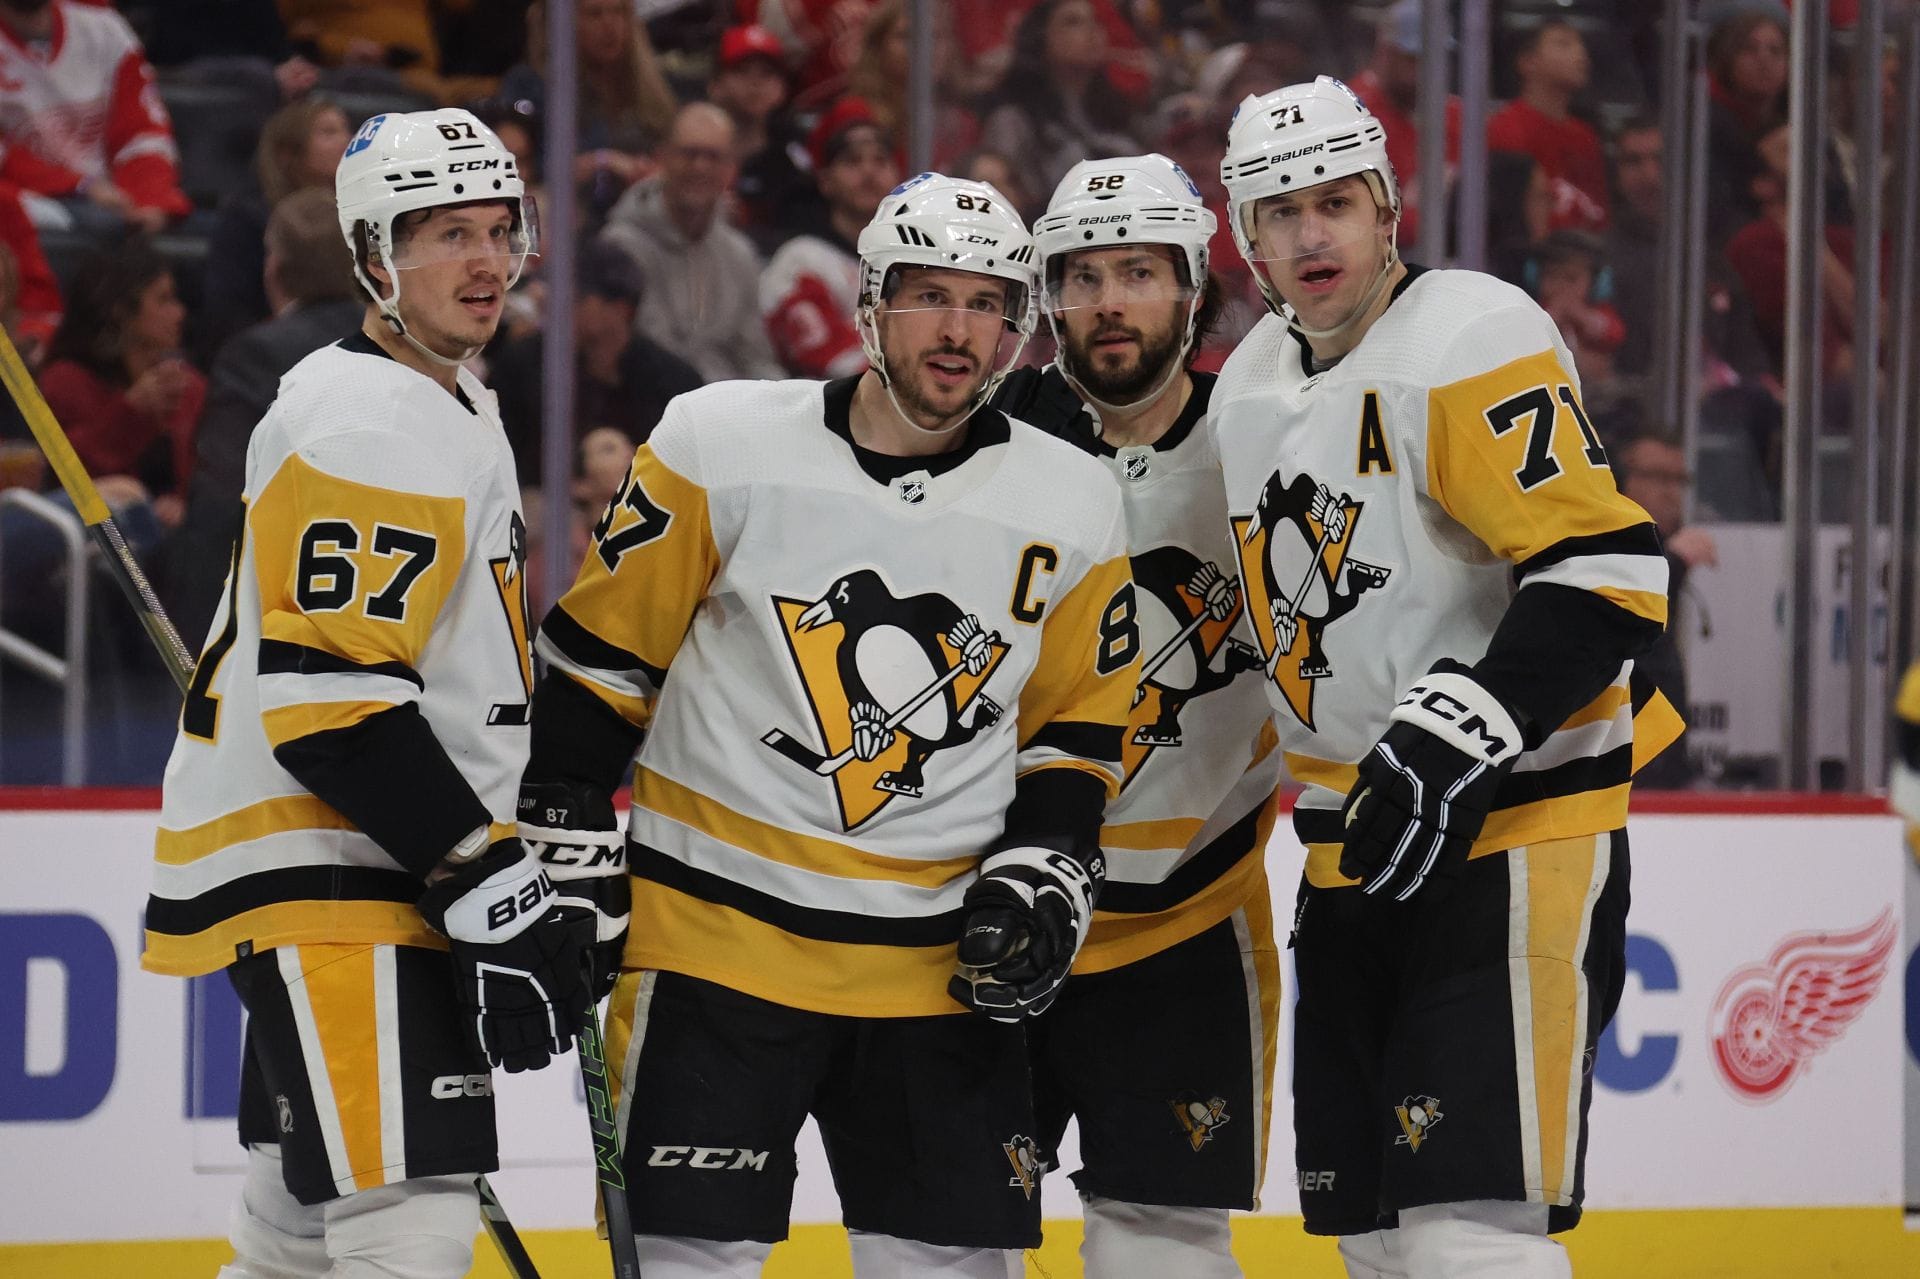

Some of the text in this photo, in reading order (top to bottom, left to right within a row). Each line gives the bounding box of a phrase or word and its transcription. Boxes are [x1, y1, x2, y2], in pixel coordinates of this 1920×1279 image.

[1270, 104, 1305, 131] 71
[436, 122, 479, 141] 67
[447, 159, 500, 173] CCM
[1087, 174, 1126, 193] 58
[955, 193, 992, 214] 87
[1356, 388, 1397, 479] A
[1481, 383, 1612, 495] 71
[295, 517, 438, 625] 67
[1008, 541, 1058, 628] C
[545, 807, 569, 824] 87
[525, 838, 625, 868] CM
[430, 1073, 492, 1099] CC
[647, 1145, 771, 1171] CCM
